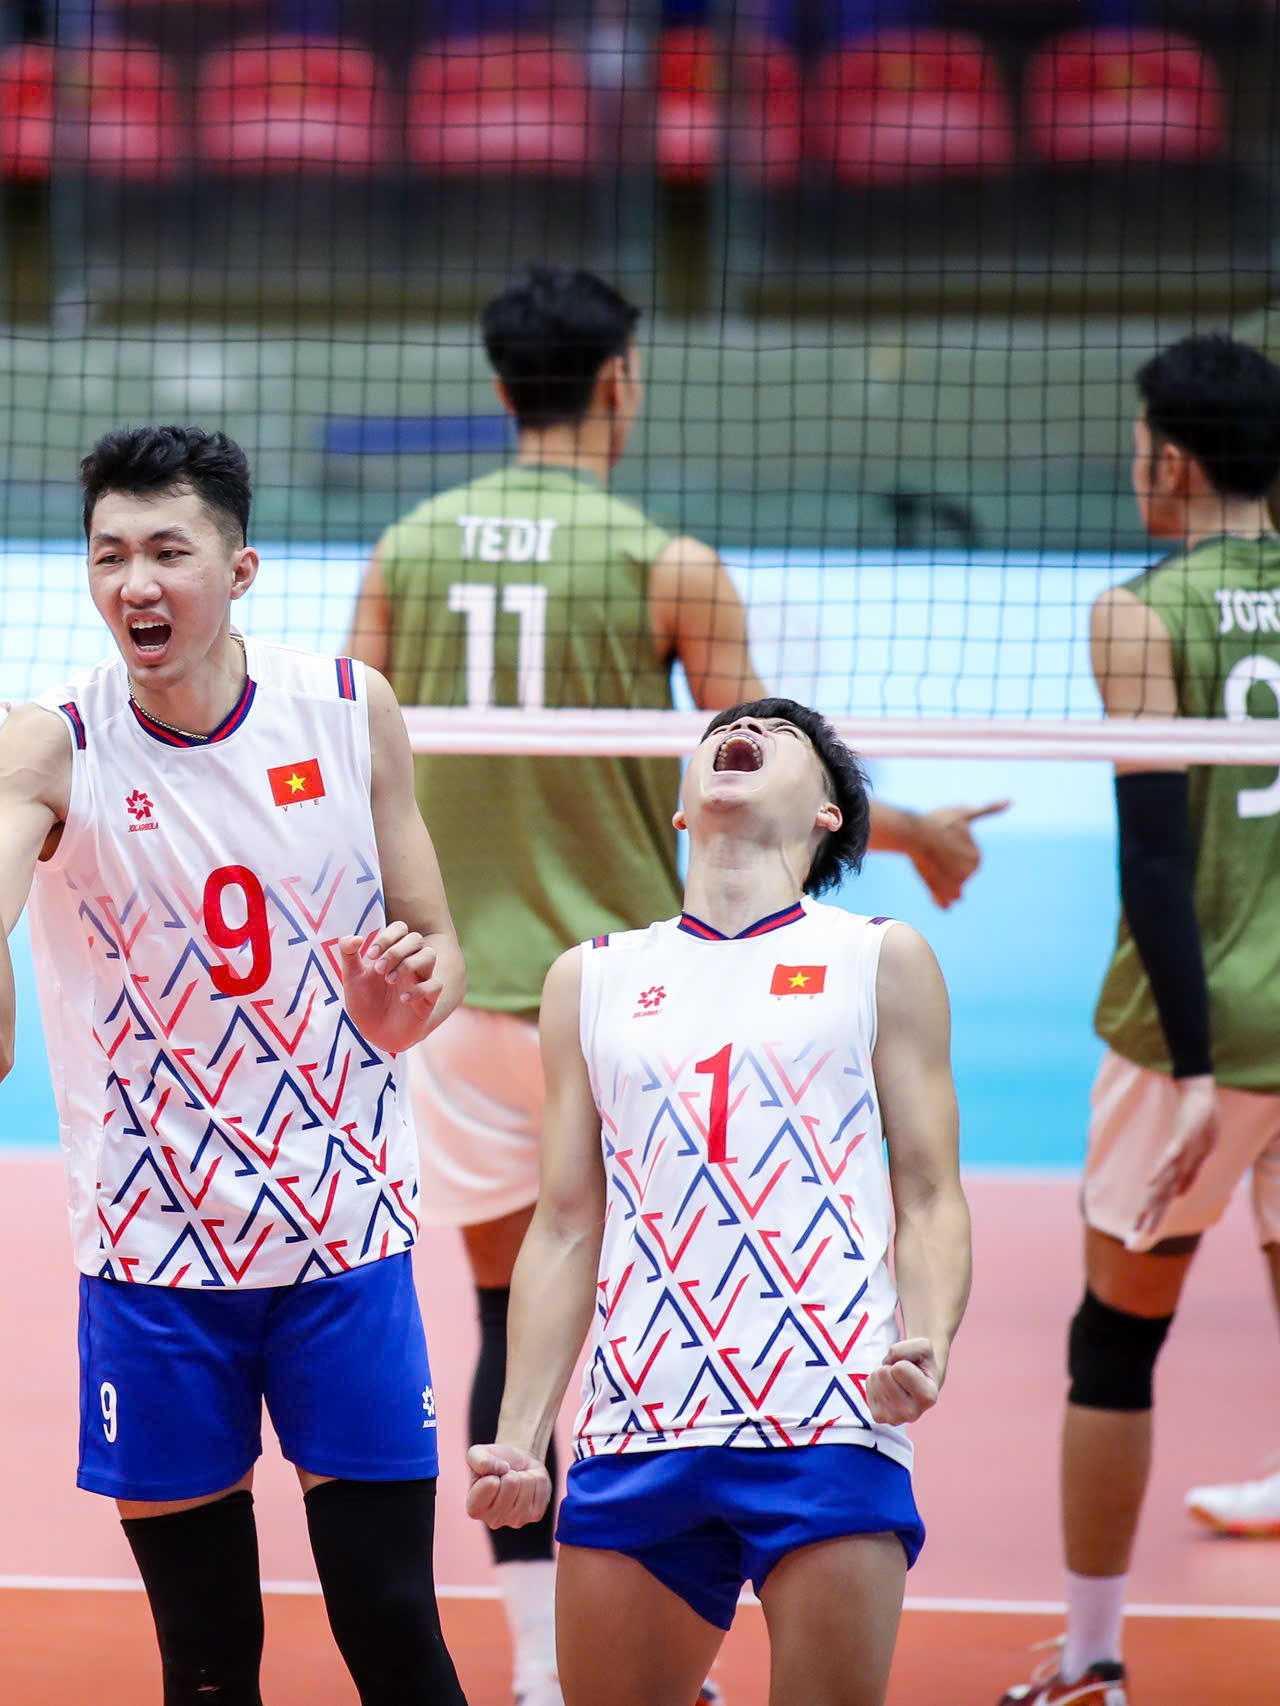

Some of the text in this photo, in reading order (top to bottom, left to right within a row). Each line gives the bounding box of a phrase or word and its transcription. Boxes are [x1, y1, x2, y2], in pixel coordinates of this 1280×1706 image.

[457, 515, 556, 562] TEDI
[448, 583, 548, 710] 11
[1214, 589, 1280, 633] JOR
[203, 864, 272, 996] 9
[695, 1042, 733, 1164] 1
[100, 1382, 118, 1443] 9
